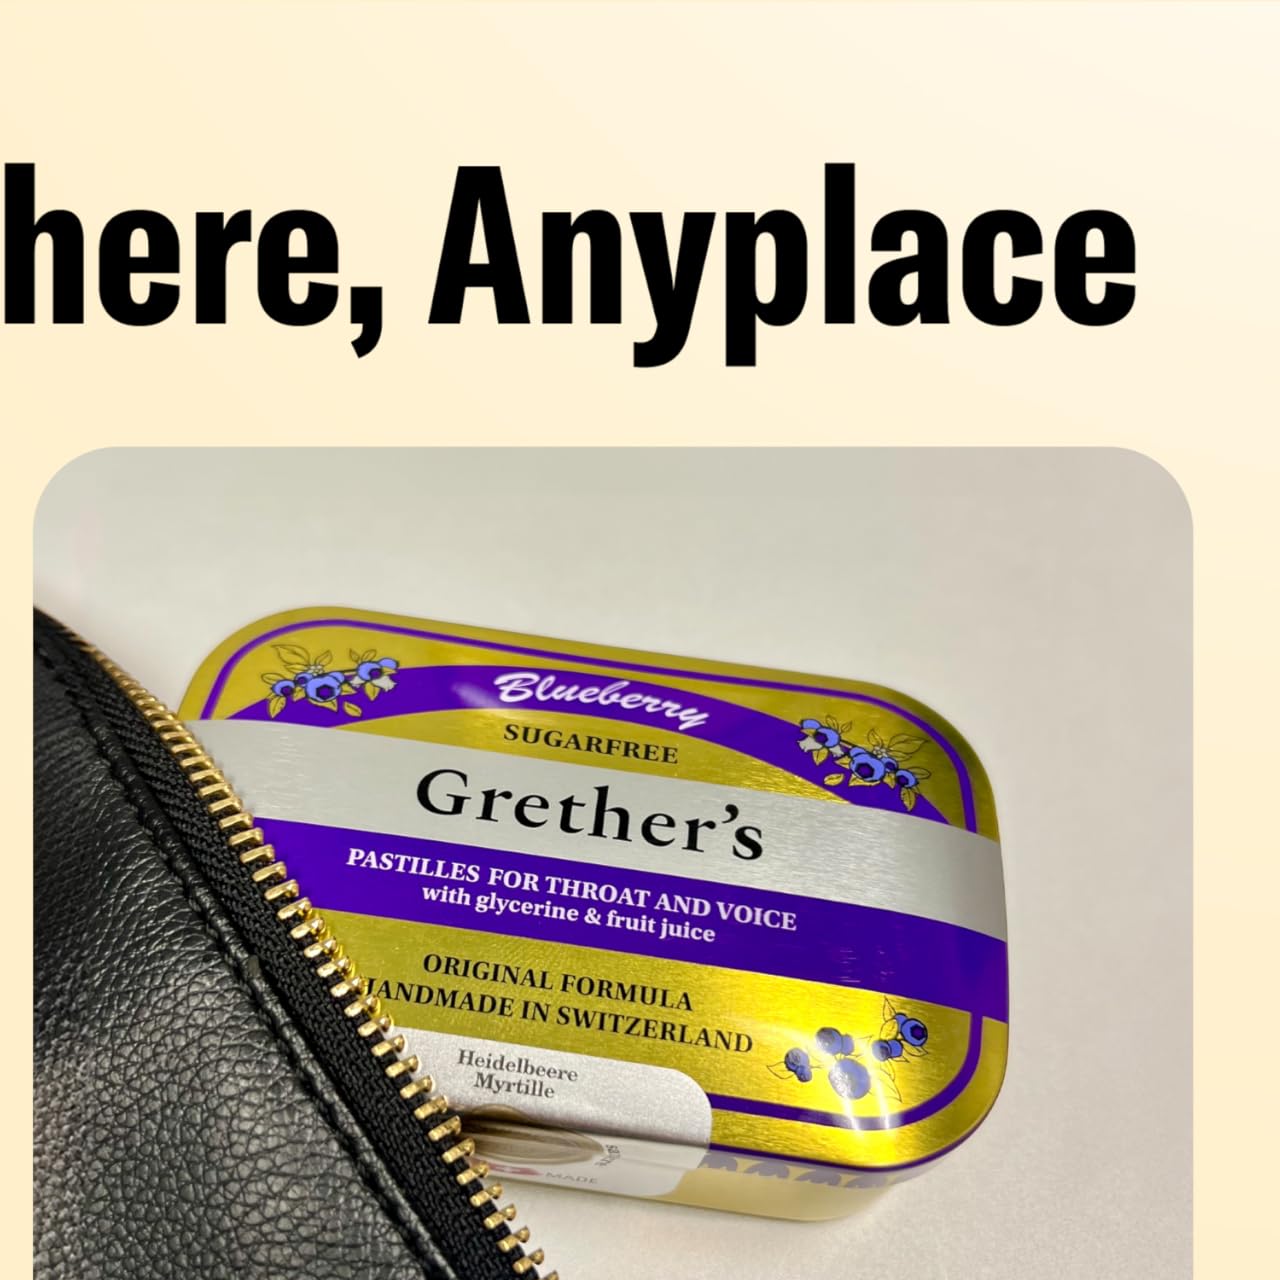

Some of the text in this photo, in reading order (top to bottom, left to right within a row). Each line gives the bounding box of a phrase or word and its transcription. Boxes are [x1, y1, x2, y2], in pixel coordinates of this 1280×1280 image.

[494, 672, 711, 730] Blueberry
[503, 724, 679, 765] SUGARFREE
[346, 845, 797, 932] PASTILLES FOR THROAT AND VOICE
[422, 885, 716, 942] with glycerine & fruit juice
[423, 954, 694, 1011] ORIGINAL FORMULA
[521, 1001, 549, 1022] IN
[557, 1006, 754, 1054] SWITZERLAND
[457, 1049, 578, 1082] Heidelbeere
[473, 1072, 556, 1098] Myrtille
